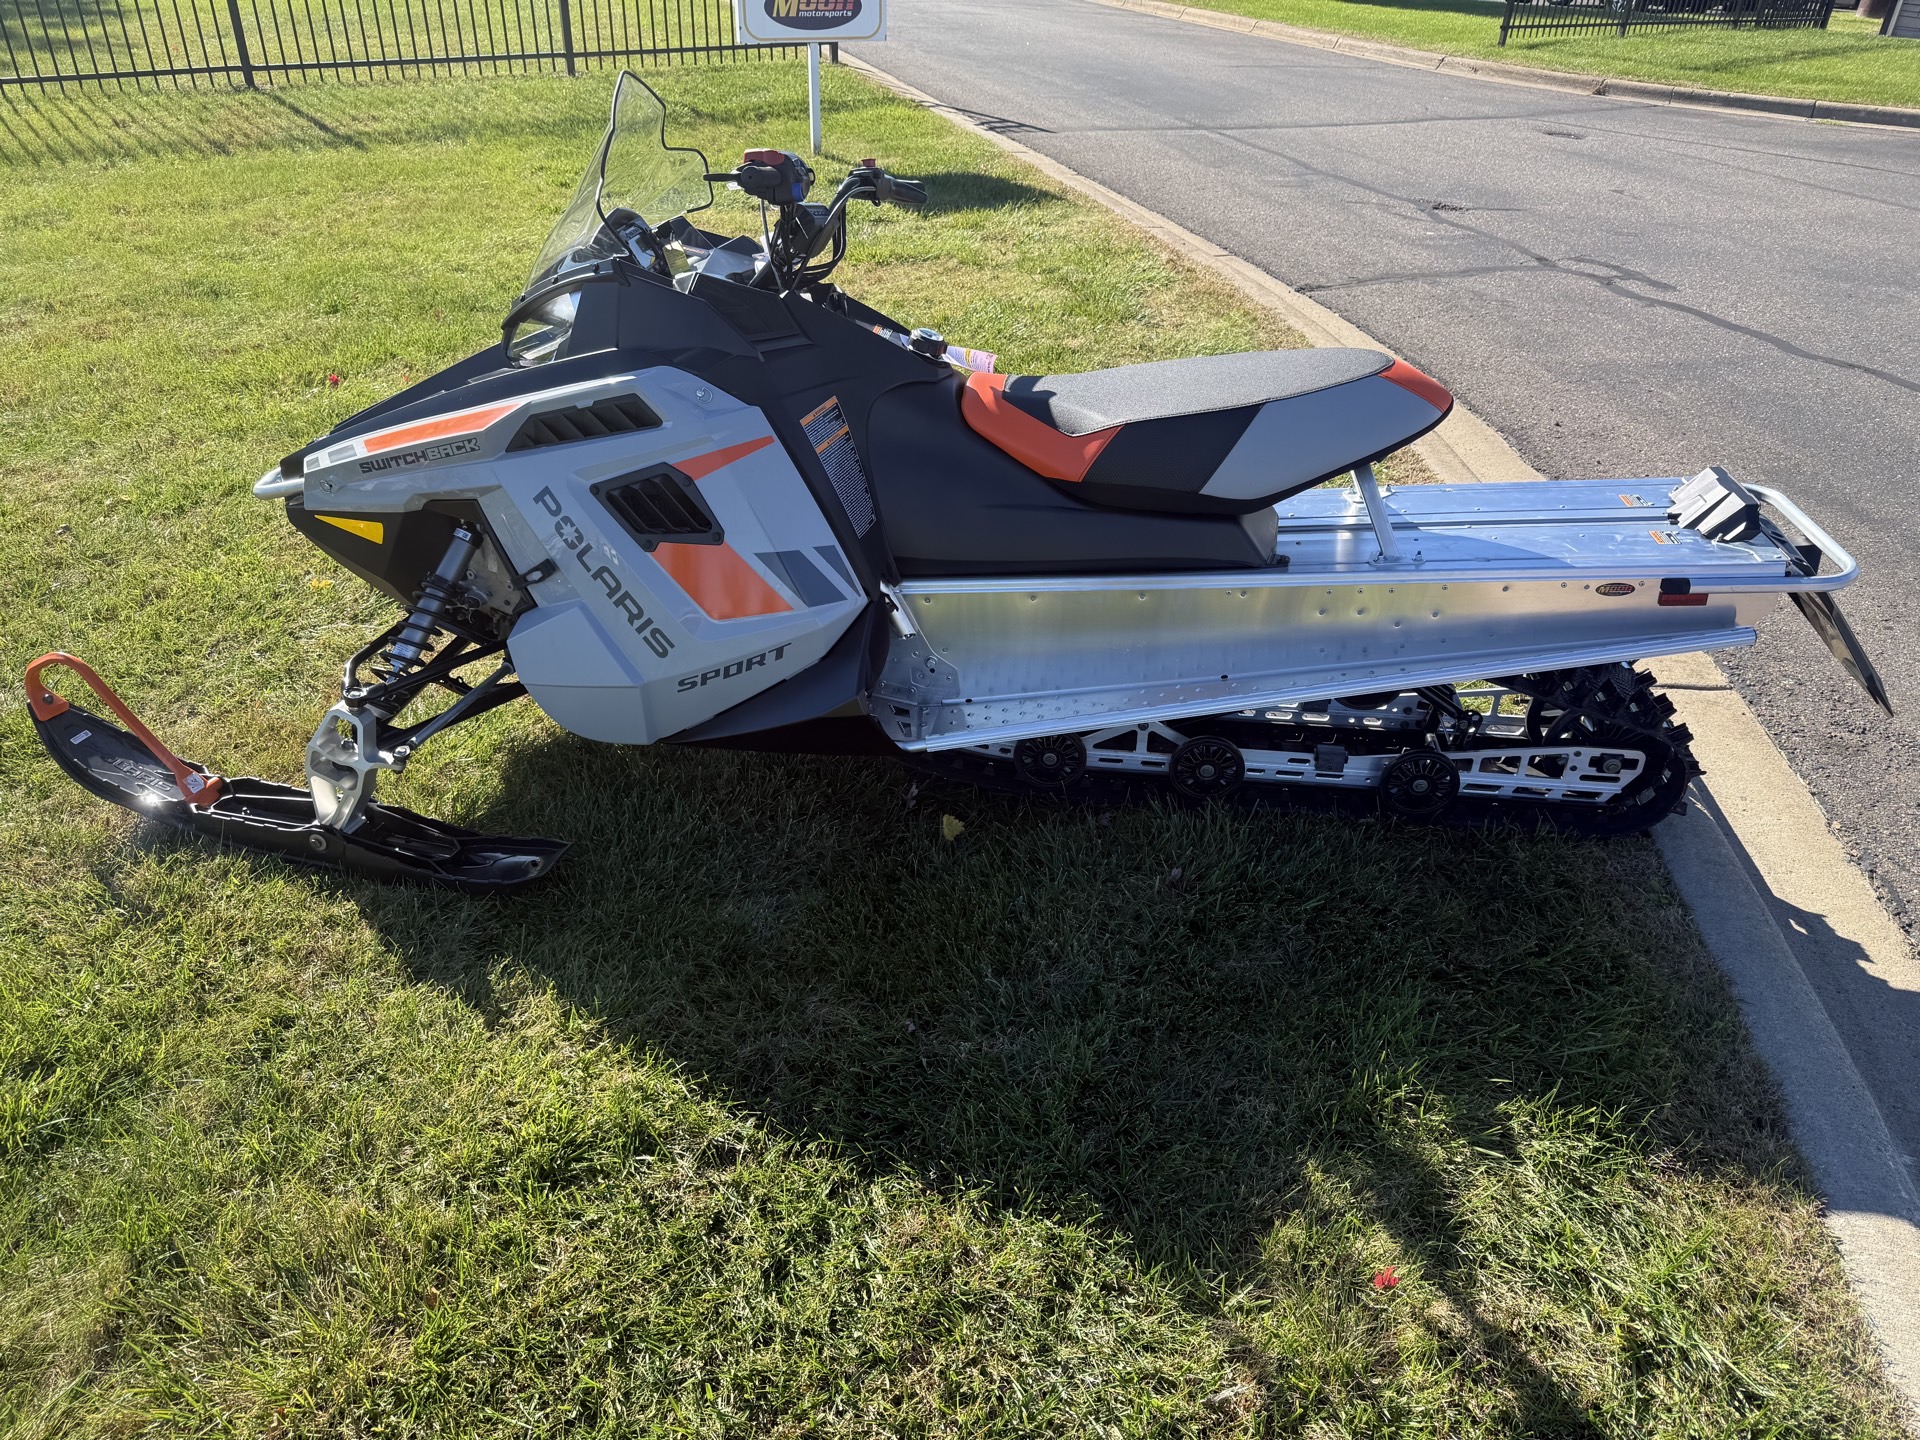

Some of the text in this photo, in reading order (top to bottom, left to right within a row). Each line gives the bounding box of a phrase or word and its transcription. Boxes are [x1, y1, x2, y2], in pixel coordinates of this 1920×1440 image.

[798, 10, 853, 18] motorsports
[358, 437, 481, 474] SWITCHBACK
[532, 485, 676, 659] POLARIS
[676, 642, 793, 693] SPORT
